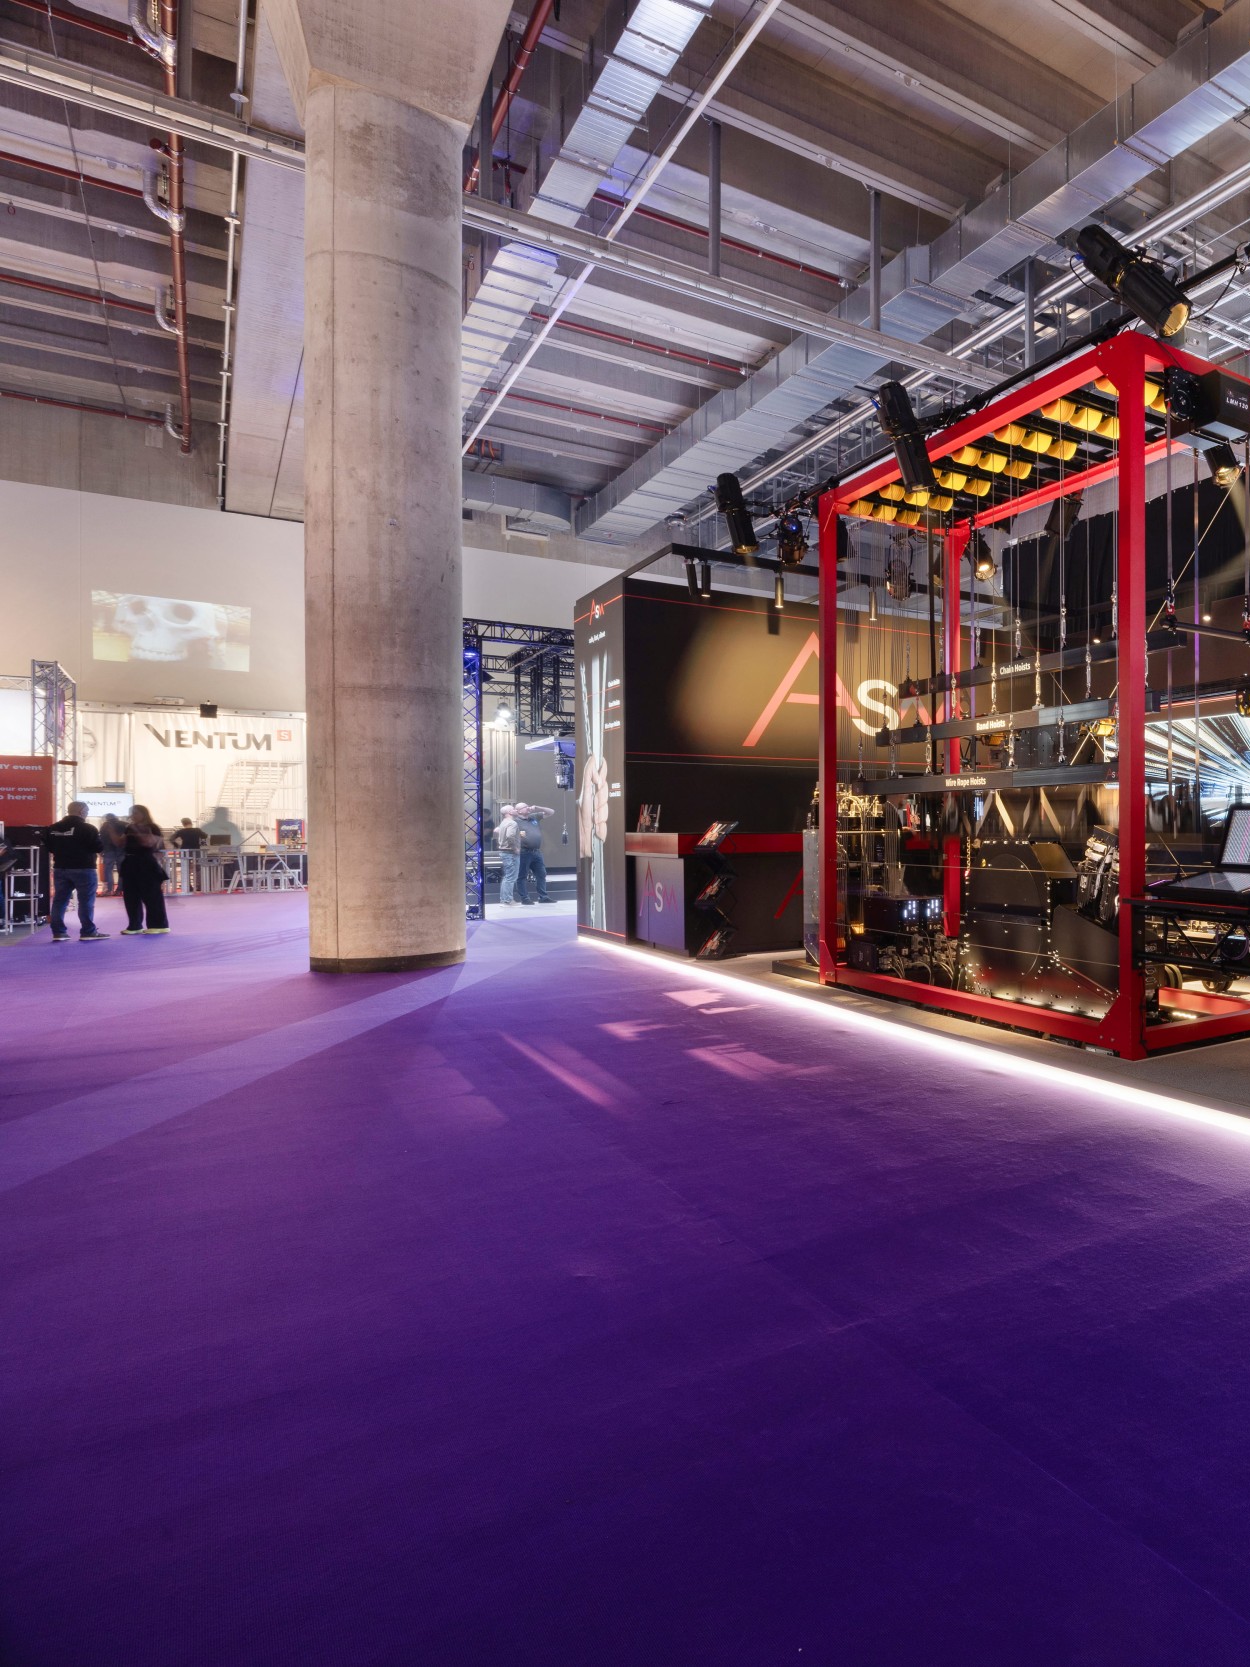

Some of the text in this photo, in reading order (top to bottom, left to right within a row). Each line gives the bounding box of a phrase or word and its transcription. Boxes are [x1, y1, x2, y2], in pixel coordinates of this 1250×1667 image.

[1000, 662, 1031, 675] Chain Hoists
[976, 719, 1006, 731] Band Hoists
[144, 723, 272, 751] VENTUM
[957, 778, 970, 788] Rope
[970, 776, 987, 786] Hoists
